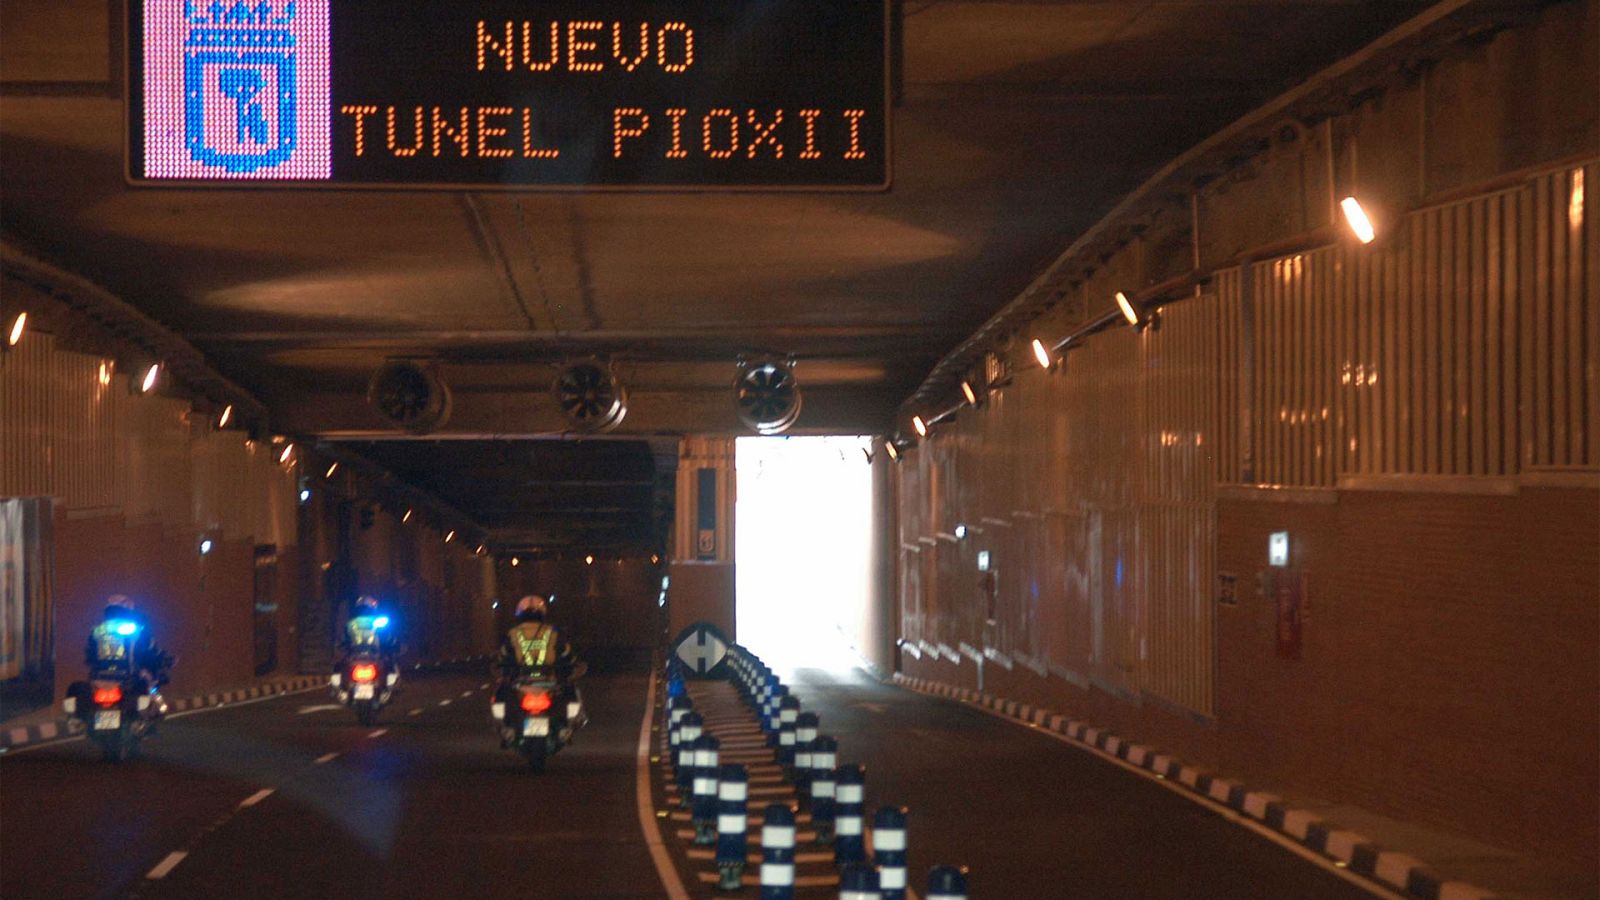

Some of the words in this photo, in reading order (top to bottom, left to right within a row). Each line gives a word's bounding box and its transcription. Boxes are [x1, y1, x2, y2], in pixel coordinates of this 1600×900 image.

[476, 20, 695, 73] NUEVO
[340, 104, 560, 158] TUNEL
[613, 107, 867, 159] PIOXII
